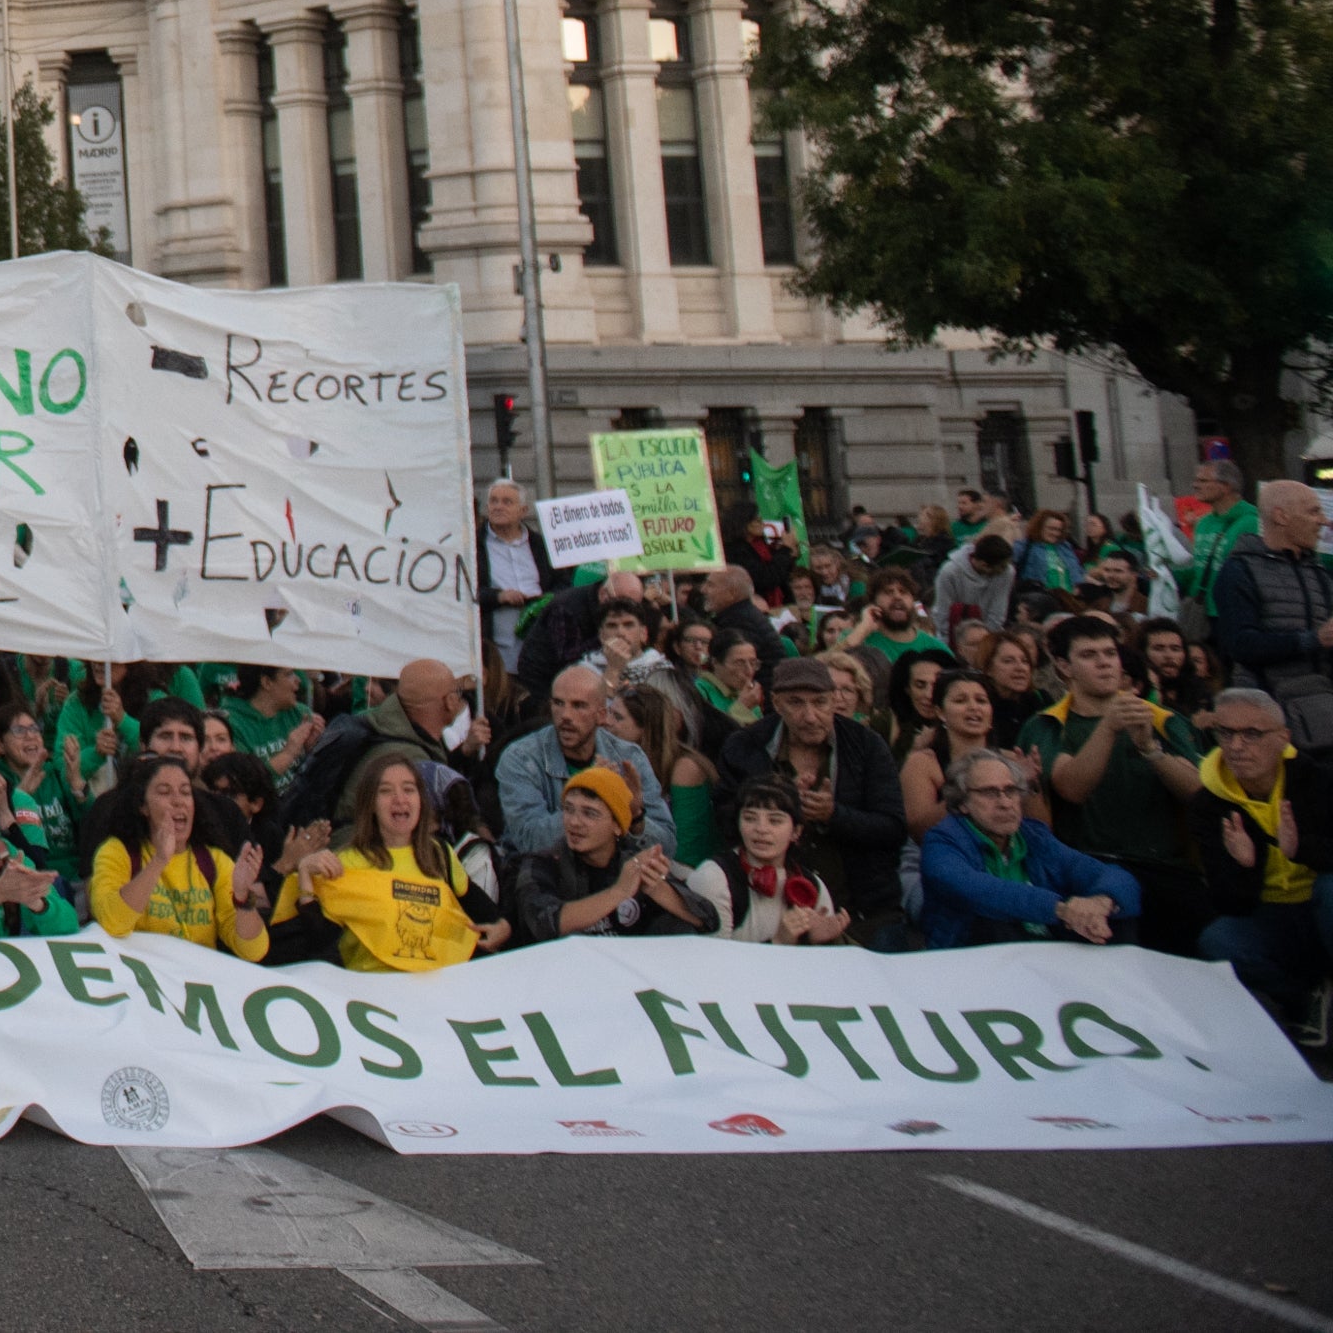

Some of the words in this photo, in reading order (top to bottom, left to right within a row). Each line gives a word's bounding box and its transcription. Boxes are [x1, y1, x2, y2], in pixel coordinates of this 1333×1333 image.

[79, 147, 118, 159] MADRID
[226, 334, 449, 405] RECORTES
[605, 443, 631, 461] LA
[639, 437, 699, 457] ESCUELA
[656, 482, 674, 494] LA
[549, 503, 563, 530] ¿El
[564, 502, 590, 522] dinero
[591, 500, 600, 518] de
[601, 497, 626, 517] todos
[633, 497, 678, 513] emilla
[554, 535, 573, 554] para
[574, 529, 600, 548] educar
[601, 530, 608, 542] a
[608, 521, 633, 542] ricos?
[643, 517, 696, 536] FUTURO
[201, 482, 478, 605] EDUCACIÓN
[446, 1013, 622, 1088] EL
[634, 988, 1212, 1084] FUTURO.
